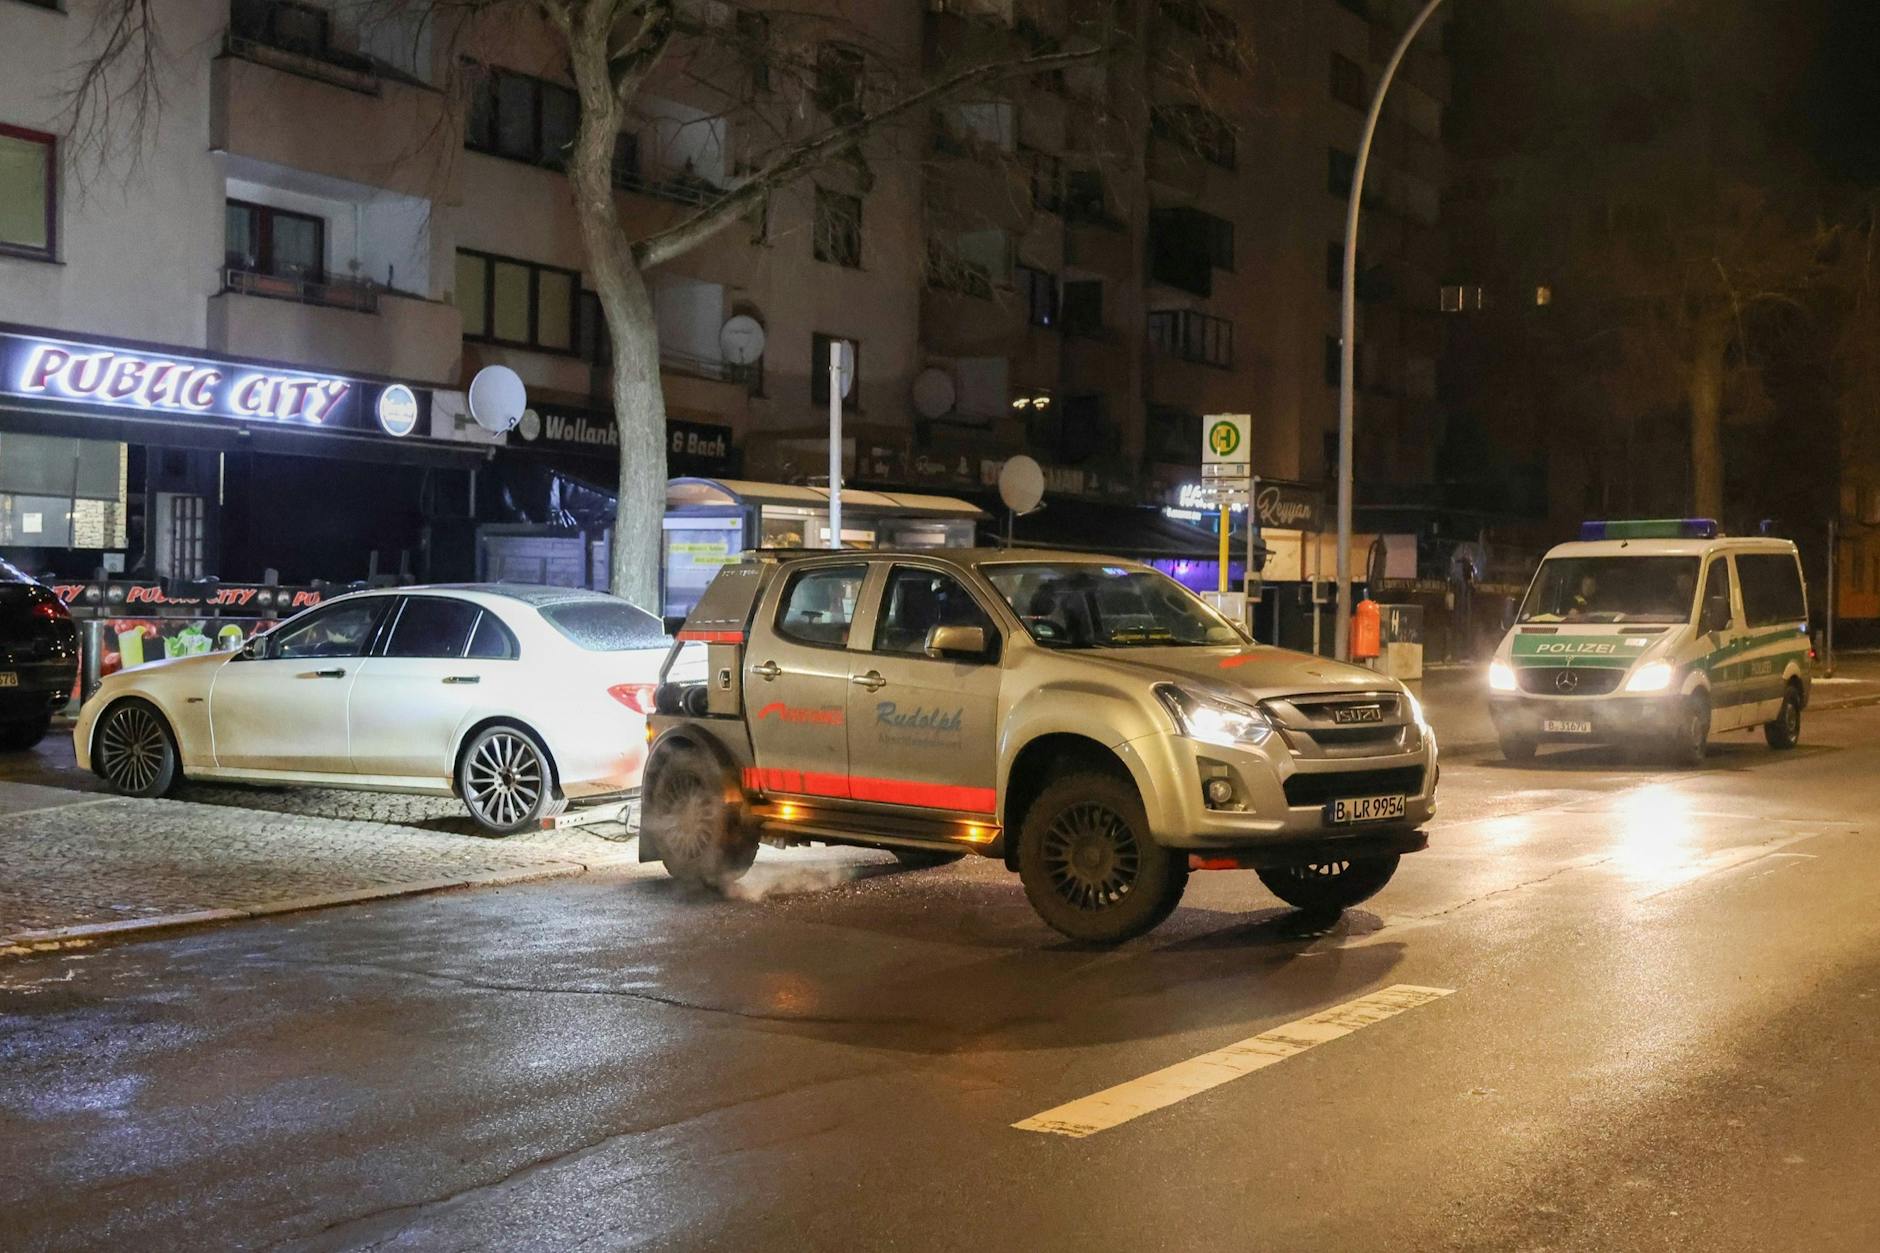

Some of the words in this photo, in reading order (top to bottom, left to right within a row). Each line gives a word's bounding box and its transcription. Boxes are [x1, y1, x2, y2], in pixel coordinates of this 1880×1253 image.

[22, 346, 223, 409] PUBLIC
[230, 374, 350, 424] CITY
[1216, 429, 1231, 448] H
[1257, 487, 1312, 525] Reyyan
[1536, 643, 1617, 654] POLIZEI
[876, 701, 964, 731] Rudolph
[1335, 708, 1381, 721] ISUZU
[1336, 802, 1345, 820] B
[1354, 800, 1370, 818] LR
[1373, 797, 1404, 817] 9954
